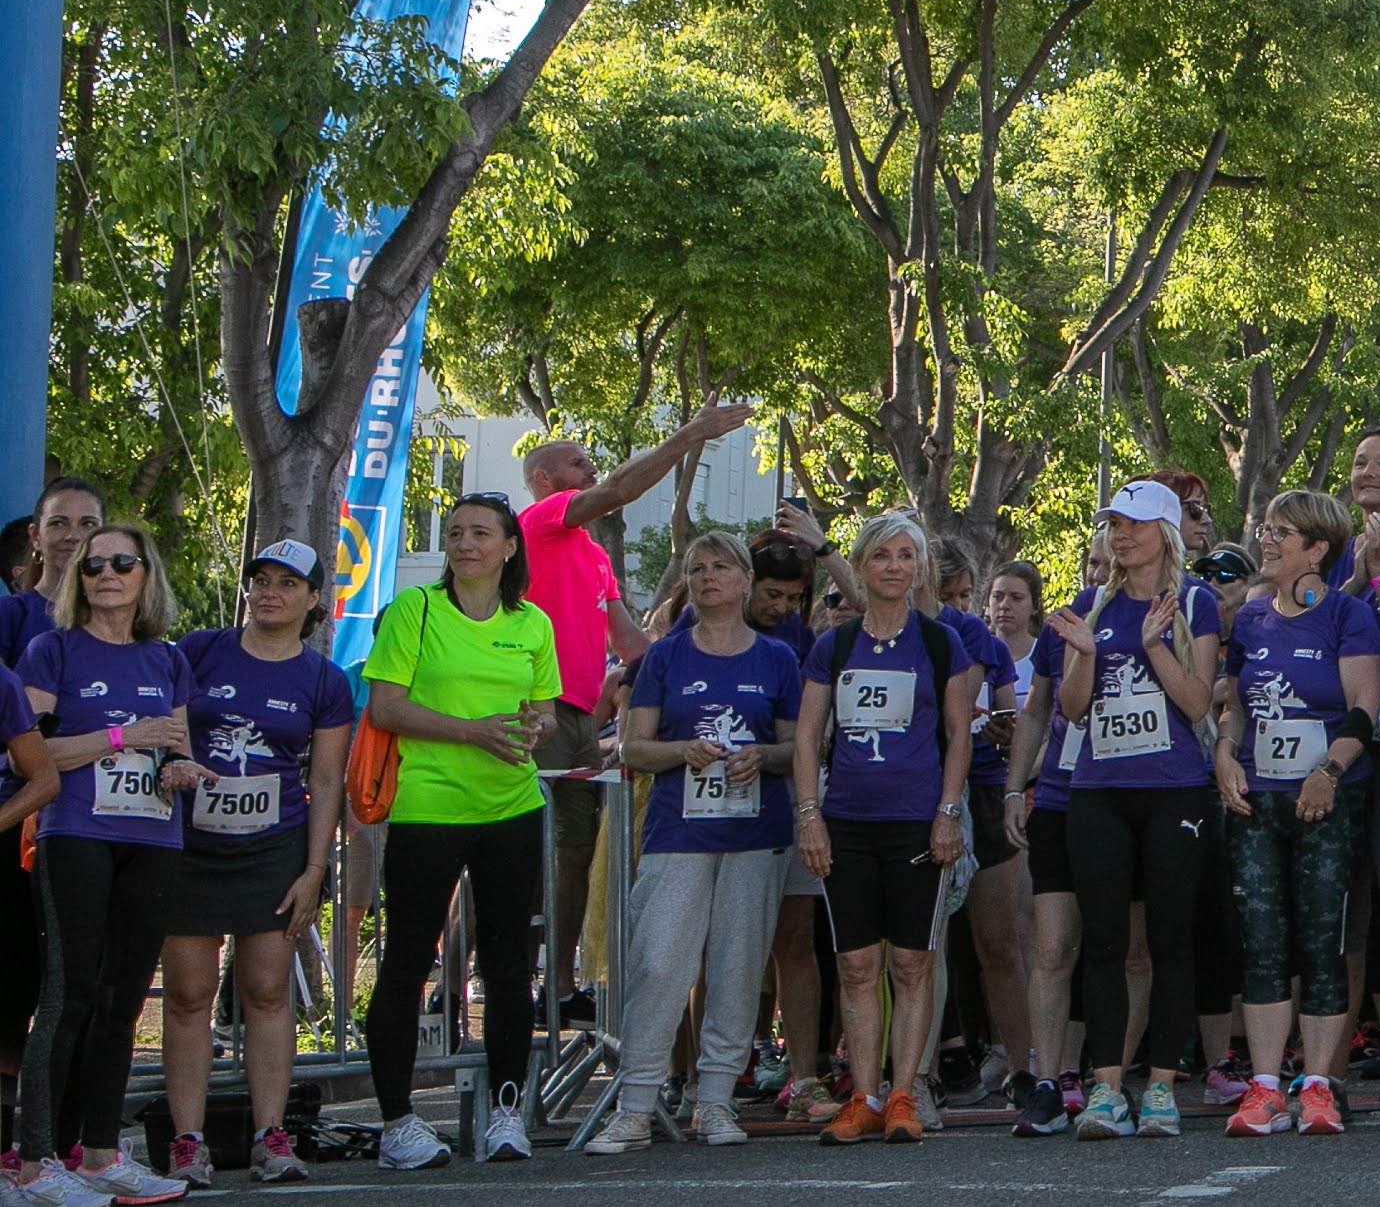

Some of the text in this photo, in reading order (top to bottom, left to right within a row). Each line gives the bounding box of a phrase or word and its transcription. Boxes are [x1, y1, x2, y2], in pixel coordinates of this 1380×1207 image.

[857, 686, 888, 708] 25
[1098, 710, 1159, 739] 7530
[1271, 736, 1302, 760] 27
[694, 777, 726, 799] 75
[205, 791, 270, 815] 7500
